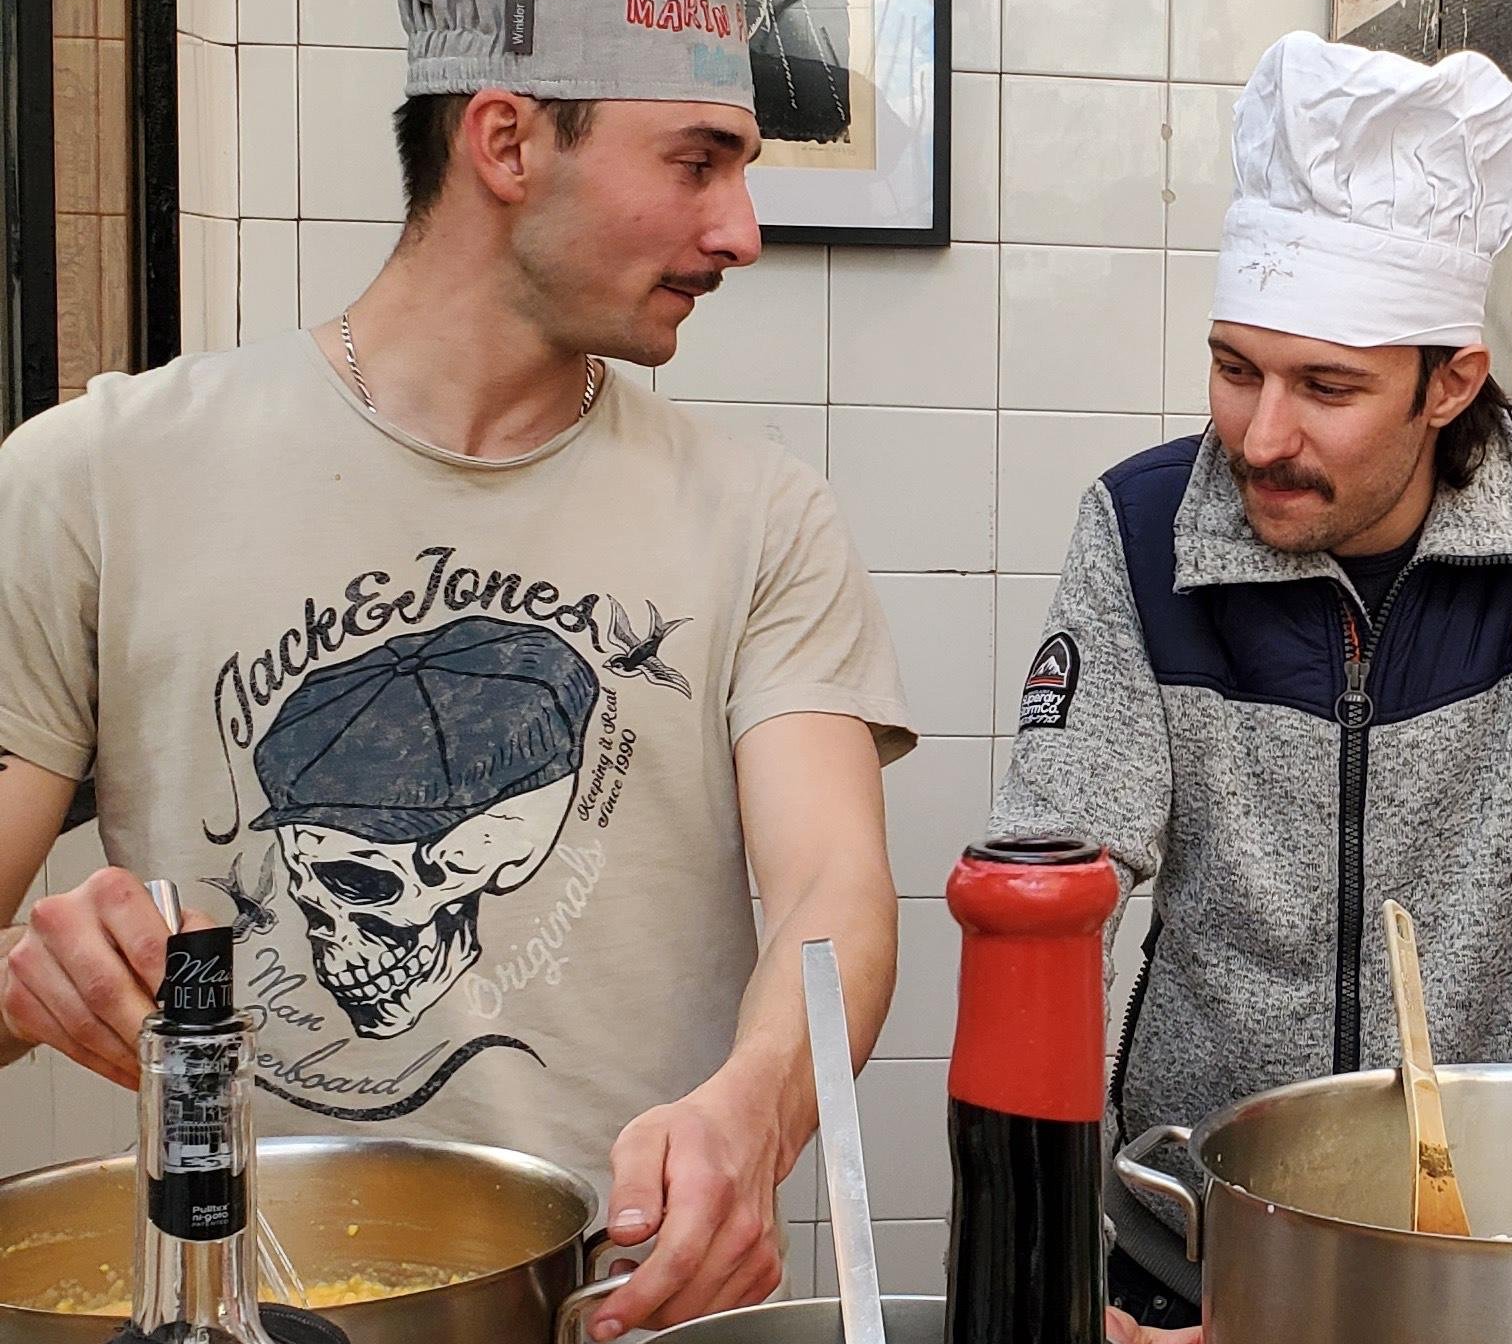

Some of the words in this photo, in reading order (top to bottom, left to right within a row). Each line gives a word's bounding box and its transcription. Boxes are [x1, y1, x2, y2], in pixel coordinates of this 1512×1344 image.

[601, 686, 618, 734] Real
[599, 737, 613, 751] it
[614, 728, 637, 776] 1990
[577, 753, 613, 821] Keeping
[464, 838, 606, 1020] Originals
[174, 986, 193, 1009] DE
[198, 986, 217, 1009] LA
[248, 947, 326, 1032] Man
